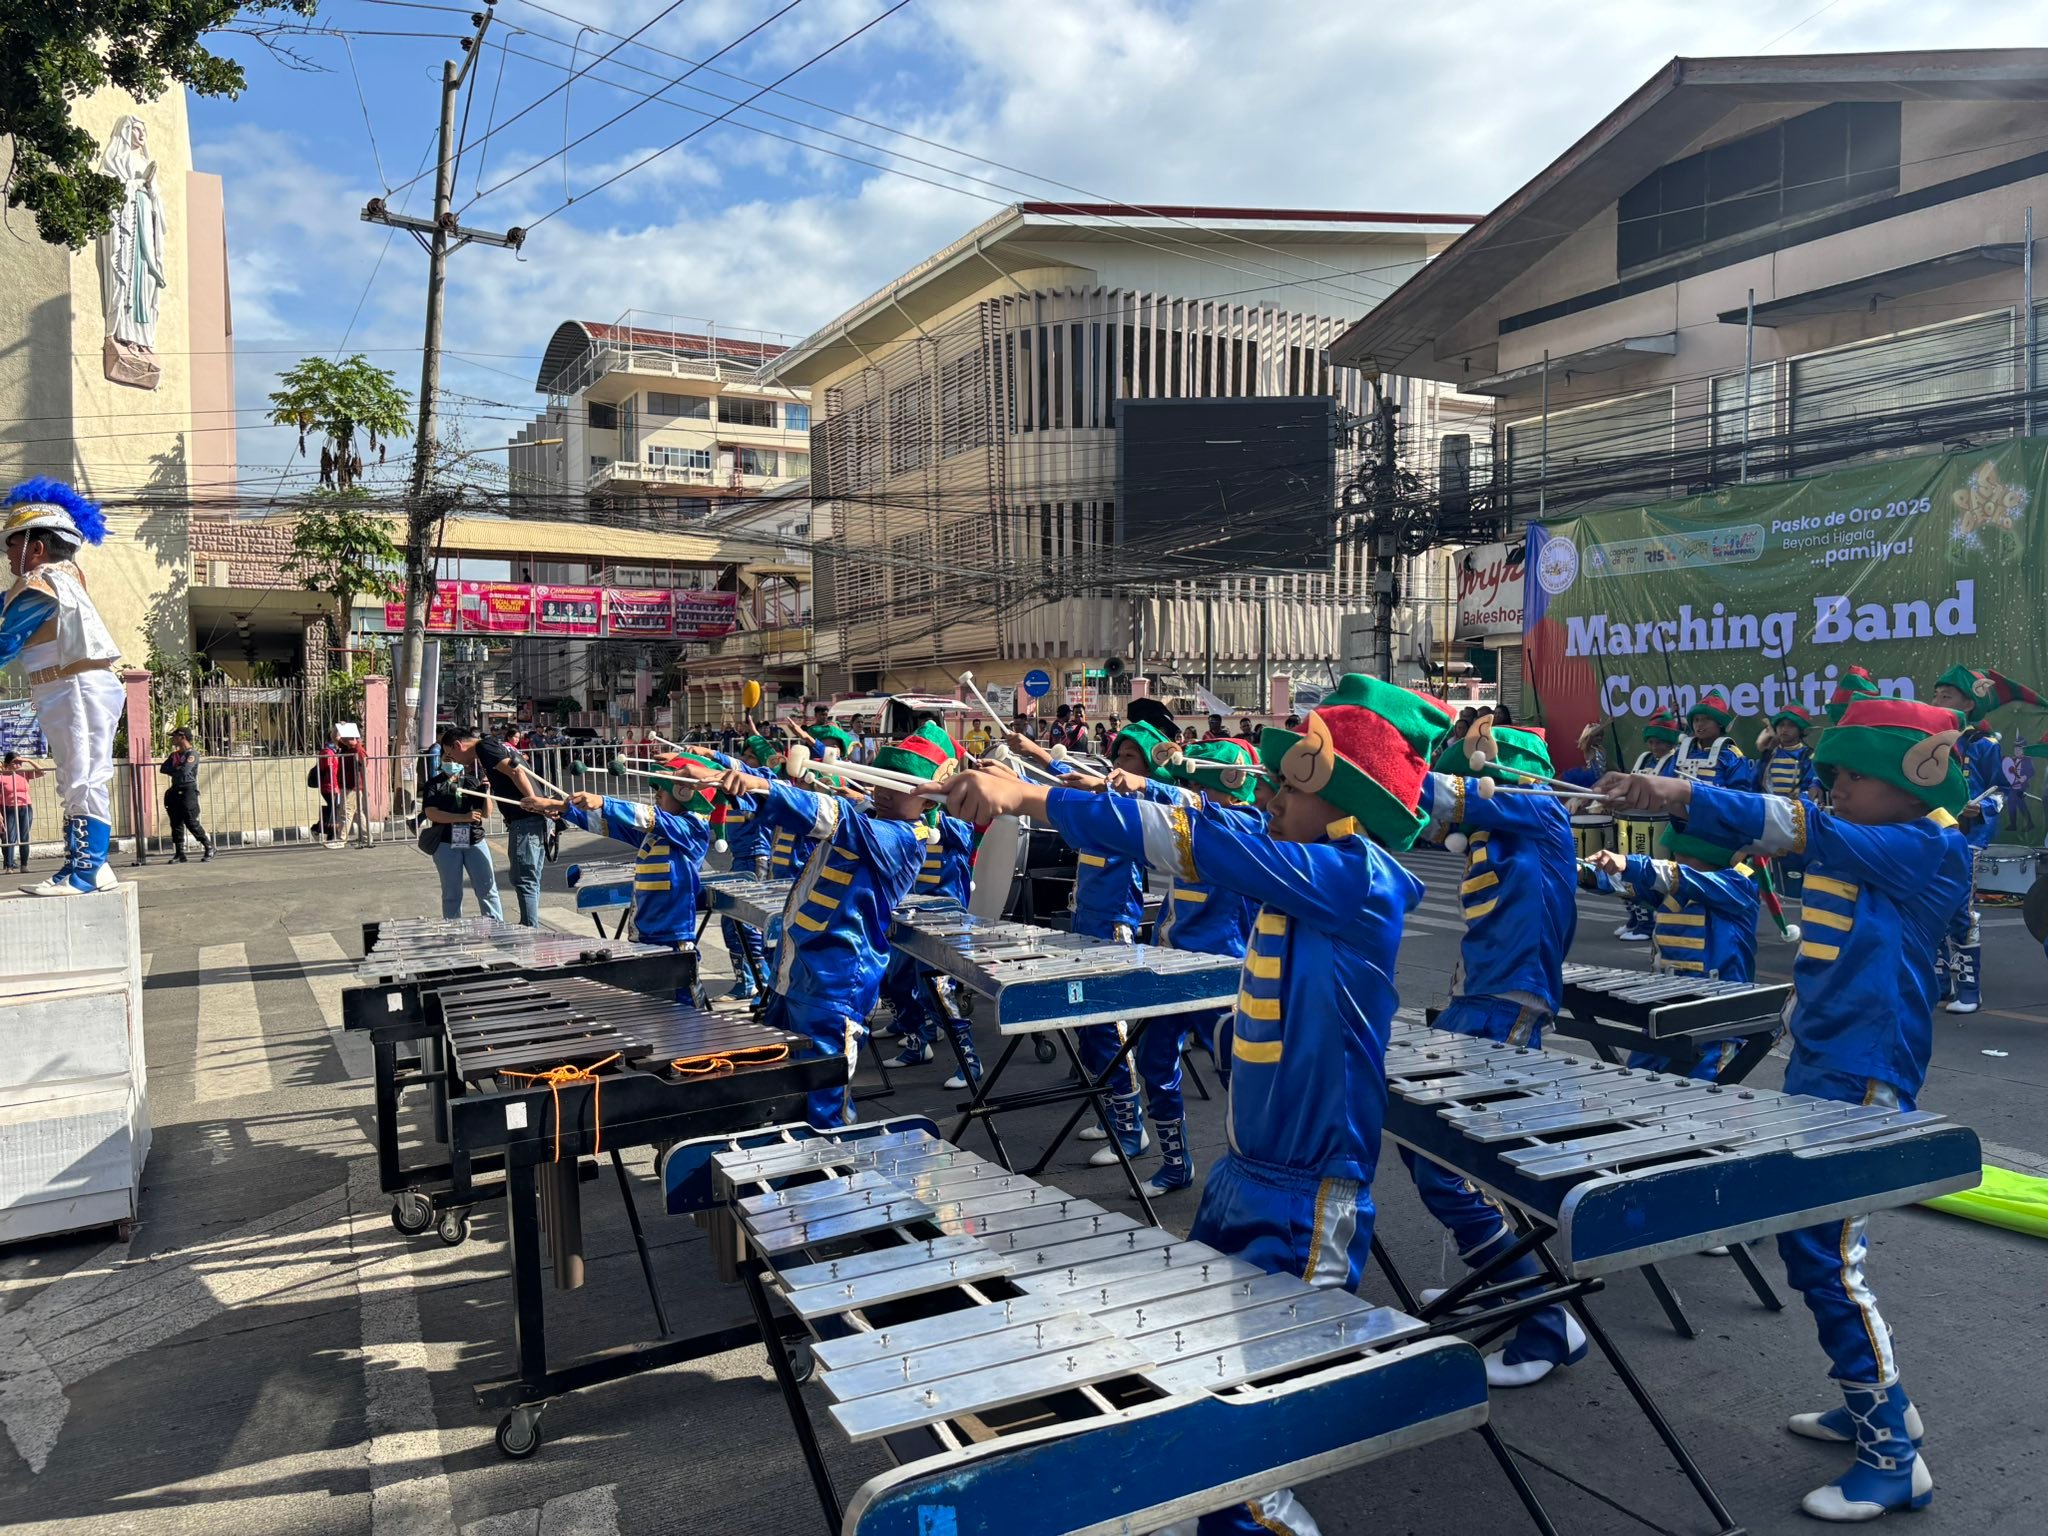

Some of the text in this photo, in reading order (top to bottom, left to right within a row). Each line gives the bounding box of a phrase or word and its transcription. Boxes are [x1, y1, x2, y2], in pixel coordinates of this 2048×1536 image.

[1771, 497, 1932, 534] Pasko de Oro 2025
[1608, 547, 1638, 558] cagayan
[1782, 528, 1875, 551] Beyond Higala
[1810, 537, 1914, 568] ...pamilya!
[1565, 579, 1977, 658] Marching Band
